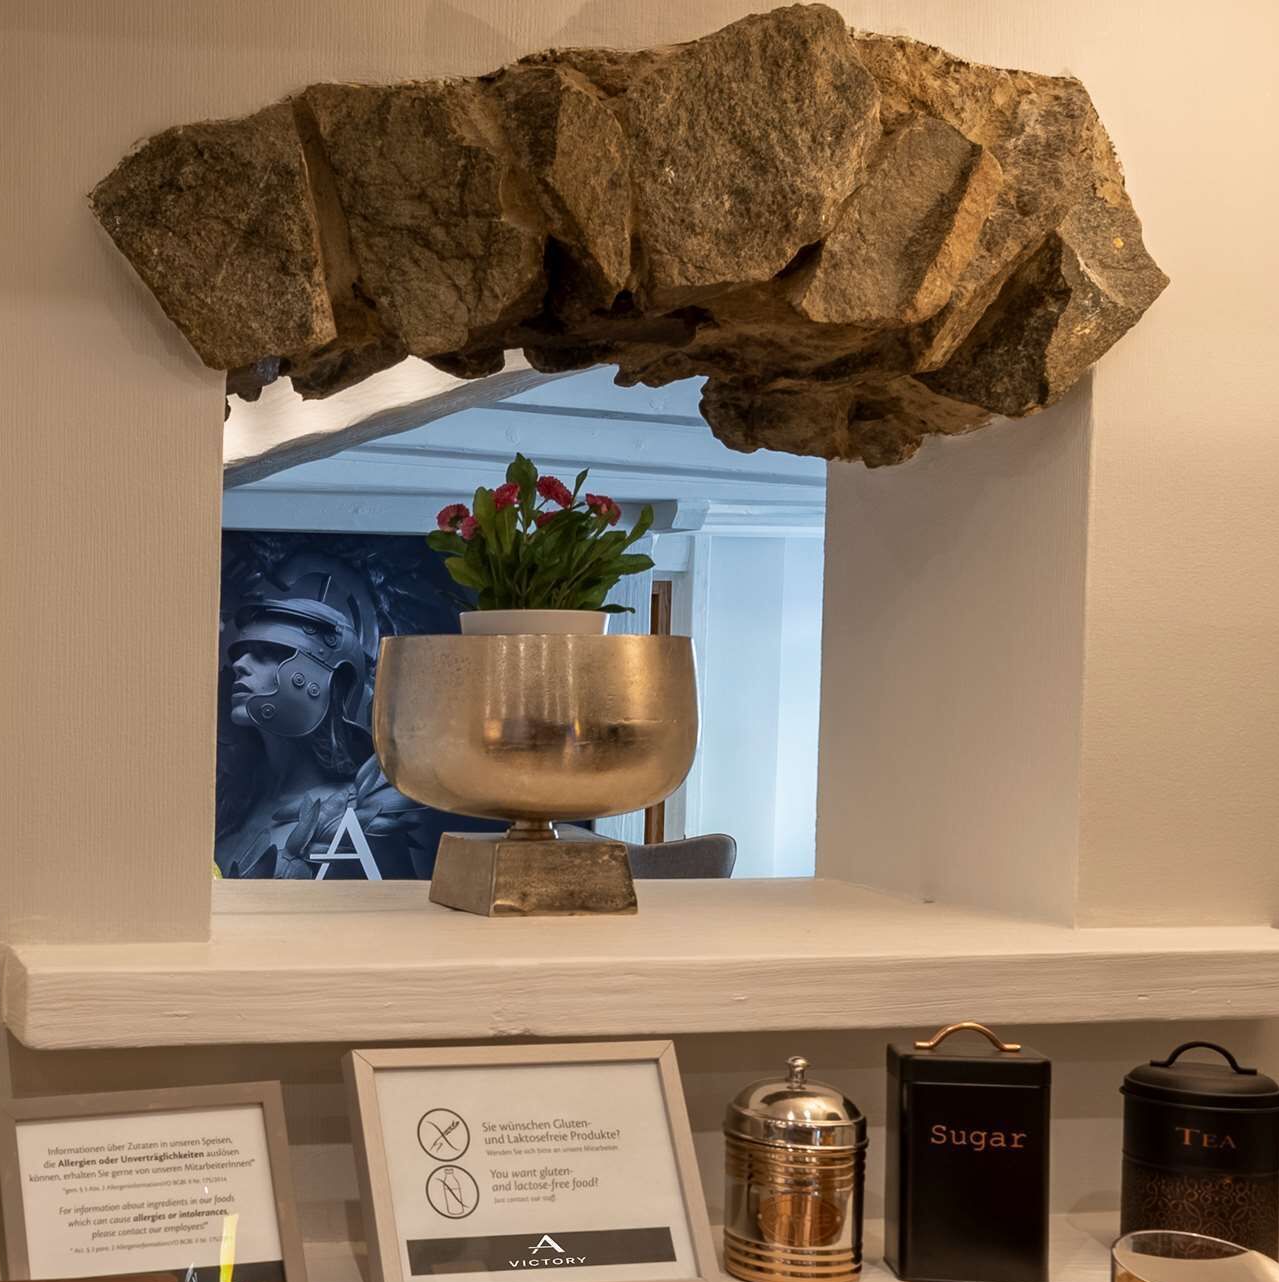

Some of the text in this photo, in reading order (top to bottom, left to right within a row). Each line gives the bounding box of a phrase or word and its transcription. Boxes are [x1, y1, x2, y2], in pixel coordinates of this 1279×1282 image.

[482, 1118, 592, 1133] Sie wünschen Gluten-
[484, 1129, 621, 1145] und Laktosefreie Produkte?
[930, 1124, 1027, 1151] Sugar
[47, 1144, 106, 1156] Informationen
[107, 1143, 125, 1152] über
[127, 1141, 159, 1151] Zutaten
[160, 1140, 168, 1148] in
[169, 1138, 201, 1147] unseren
[43, 1148, 240, 1169] die Allergien oder Unverträglichkeiten auslösen
[63, 1170, 97, 1180] erhalten
[98, 1169, 110, 1178] Sie
[111, 1169, 134, 1178] gerne
[135, 1167, 151, 1175] von
[152, 1164, 183, 1173] unseren
[489, 1166, 574, 1180] You want gluten-
[492, 1176, 599, 1192] and lactose-free food?
[59, 1206, 72, 1215] For
[74, 1202, 120, 1216] information
[122, 1201, 146, 1210] about
[190, 1197, 197, 1205] in
[199, 1196, 212, 1204] our
[68, 1218, 91, 1228] which
[93, 1217, 108, 1225] can
[109, 1215, 131, 1224] cause
[133, 1212, 166, 1223] allergies
[168, 1212, 177, 1220] or
[91, 1230, 117, 1240] please
[118, 1227, 147, 1237] contact
[149, 1225, 162, 1234] our
[508, 1256, 587, 1268] VICTORY
